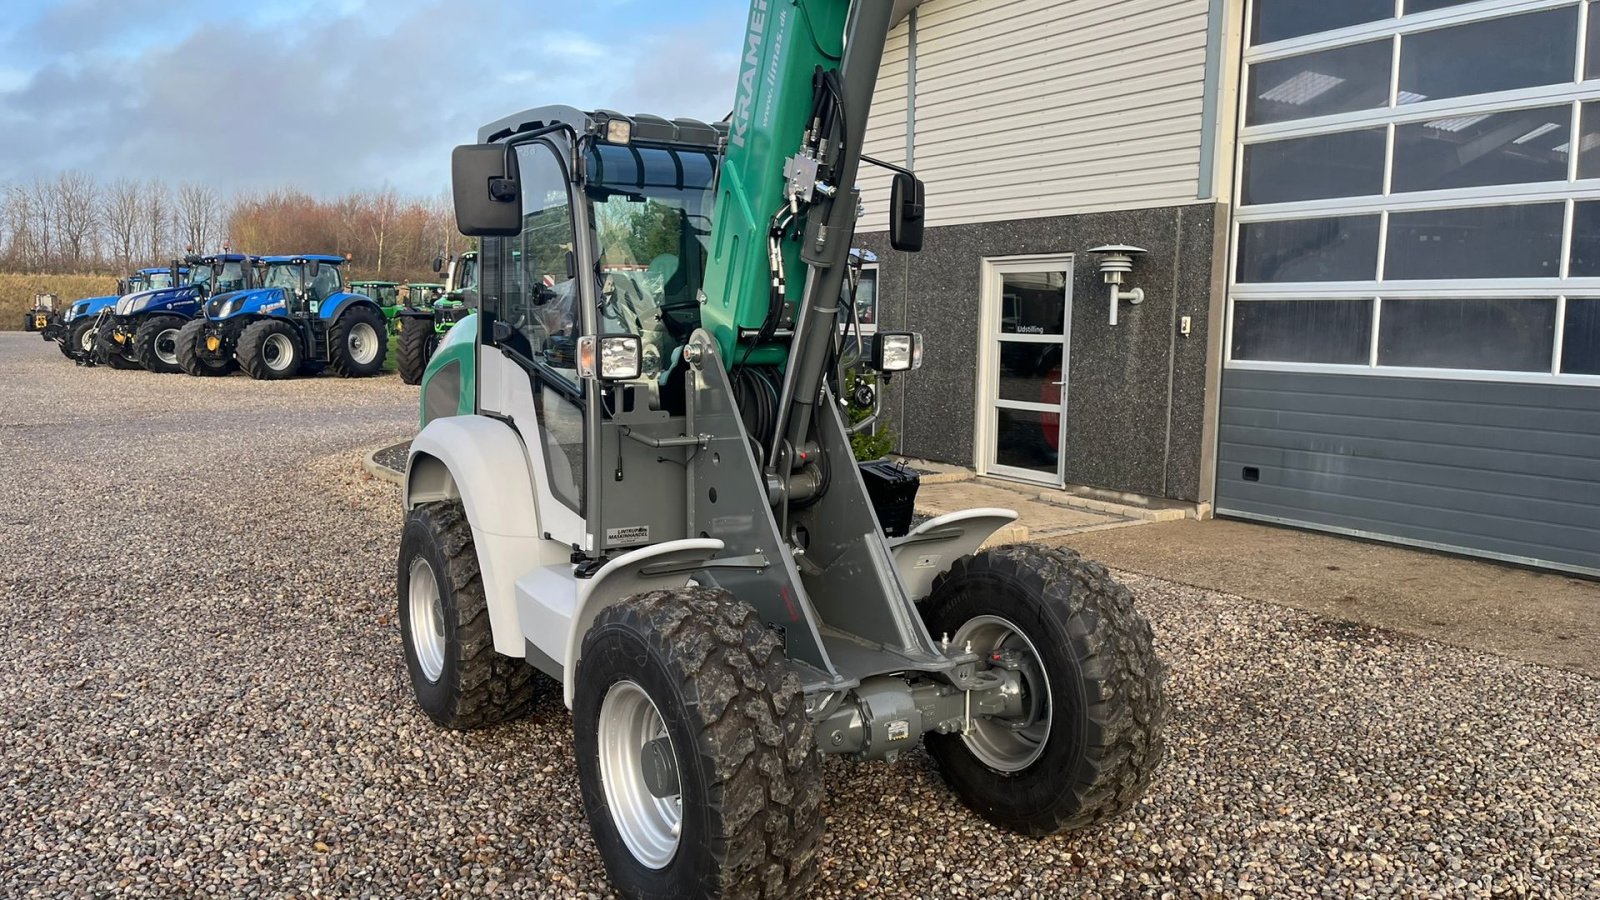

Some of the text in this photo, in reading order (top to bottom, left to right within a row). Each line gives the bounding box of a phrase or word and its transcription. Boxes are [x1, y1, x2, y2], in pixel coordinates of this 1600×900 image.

[763, 10, 787, 127] www.limas.dk
[1017, 325, 1044, 334] Udstilling
[608, 532, 648, 540] MASKINHANDEL
